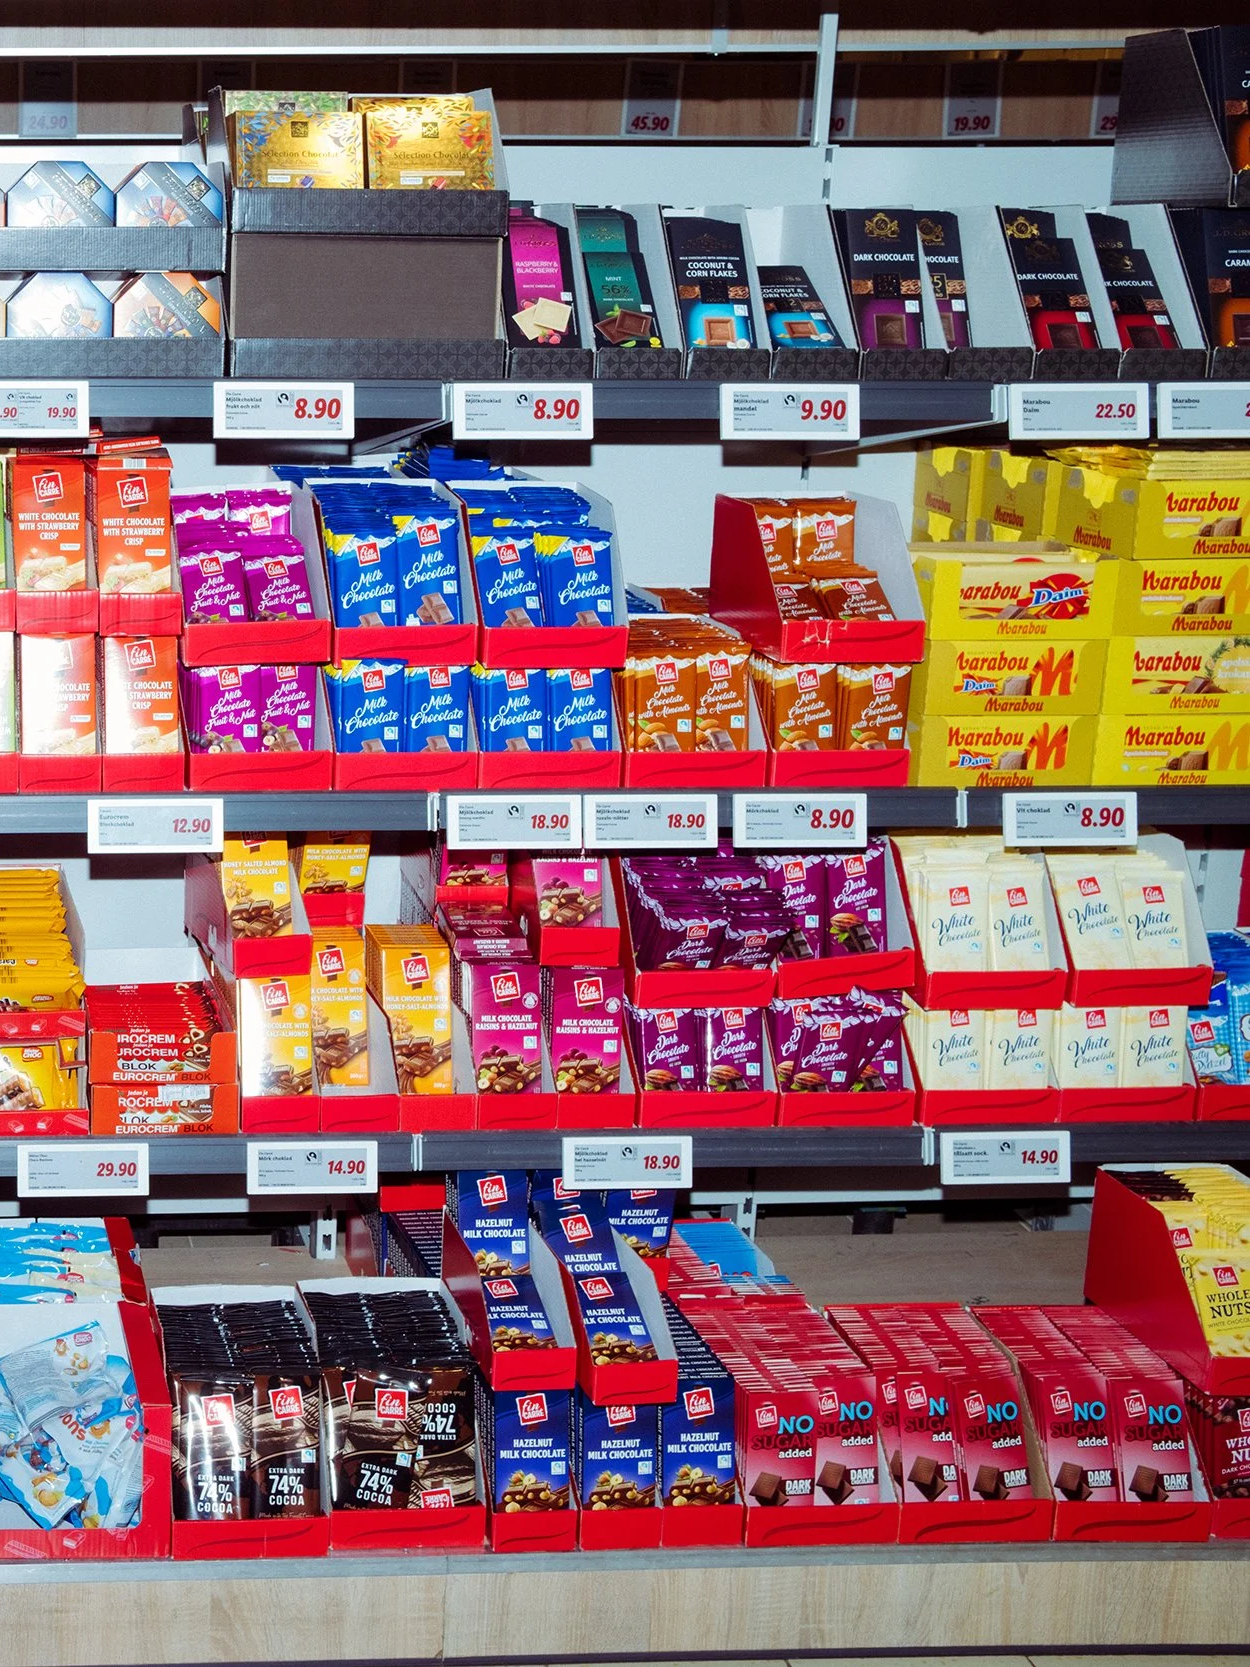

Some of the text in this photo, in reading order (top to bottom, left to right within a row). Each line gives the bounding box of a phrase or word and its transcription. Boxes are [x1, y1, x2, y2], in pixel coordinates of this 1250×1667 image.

[631, 116, 670, 131] 45.90
[954, 116, 991, 131] 19.90
[853, 254, 915, 262] DARK CHOCOLATE
[688, 262, 724, 270] COCONUT
[686, 270, 738, 278] CORN FLAKES
[47, 407, 77, 419] 19.90
[294, 398, 341, 419] 8.90
[534, 398, 580, 420] 8.90
[801, 400, 846, 420] 9.90
[1095, 403, 1136, 419] 22.50
[42, 512, 80, 520] CHOCOLATE
[37, 522, 79, 530] STRAWBERRY
[40, 532, 59, 540] CRISP
[202, 577, 225, 590] Milk
[352, 570, 383, 590] Milk
[194, 584, 235, 600] Chocolate
[341, 583, 395, 608] Chocolate
[1030, 587, 1085, 607] Daim
[997, 622, 1047, 635] Marabou
[1172, 617, 1232, 631] Marabou
[985, 697, 1043, 712] Marabou
[1125, 726, 1205, 746] Marabou
[531, 814, 569, 829] 18.90
[667, 813, 705, 829] 18.90
[810, 809, 854, 829] 8.90
[1081, 807, 1124, 828] 8.90
[173, 818, 211, 833] 12.90
[842, 880, 867, 895] Dark
[833, 888, 878, 908] Chocolate
[931, 912, 975, 936] White
[938, 928, 982, 947] Chocolate
[507, 1022, 538, 1030] HAZELNUT
[121, 1062, 156, 1070] BLOK
[113, 1072, 211, 1081] EUROCREM BLOK
[643, 1154, 681, 1171] 18.90
[1021, 1149, 1059, 1165] 14.90
[96, 1161, 137, 1178] 29.90
[327, 1159, 366, 1176] 14.90
[839, 1401, 873, 1421] NO
[817, 1421, 873, 1437] SUGAR
[513, 1439, 553, 1448] HAZELNUT
[842, 1435, 873, 1447] added
[501, 1449, 566, 1459] MILK CHOCOLATE
[850, 1469, 875, 1480] DARK
[269, 1475, 304, 1493] 74%
[269, 1495, 305, 1505] COCOA
